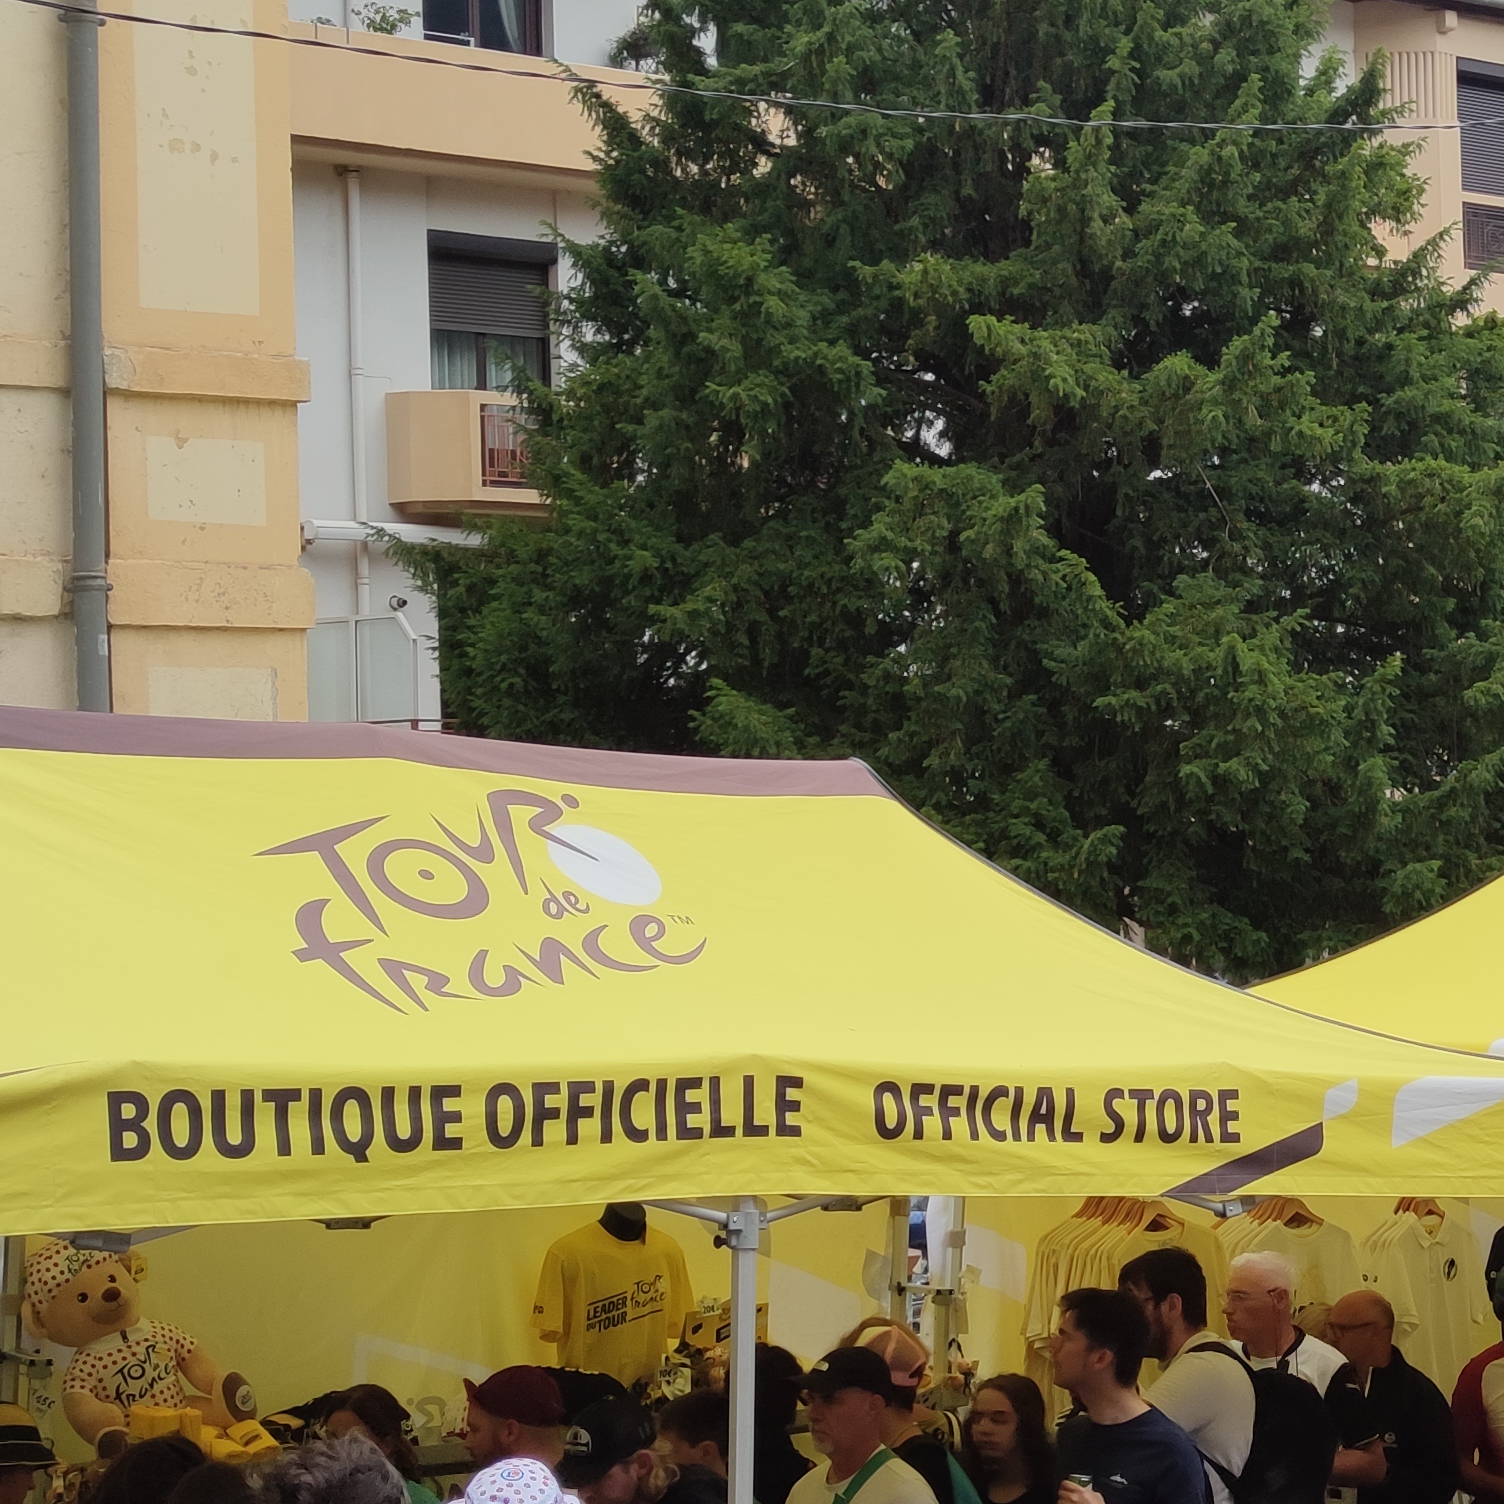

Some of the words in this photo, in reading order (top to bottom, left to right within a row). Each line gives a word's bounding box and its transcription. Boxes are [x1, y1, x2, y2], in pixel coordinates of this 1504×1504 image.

[251, 789, 599, 938] TOUR
[540, 877, 590, 920] de
[106, 1084, 464, 1164] BOUTIQUE
[484, 1074, 805, 1151] OFFICIELLE
[872, 1080, 1085, 1144] OFFICIAL
[1099, 1085, 1242, 1144] STORE
[586, 1295, 628, 1322] LEADER
[586, 1322, 597, 1332] DU
[596, 1311, 628, 1333] TOUR
